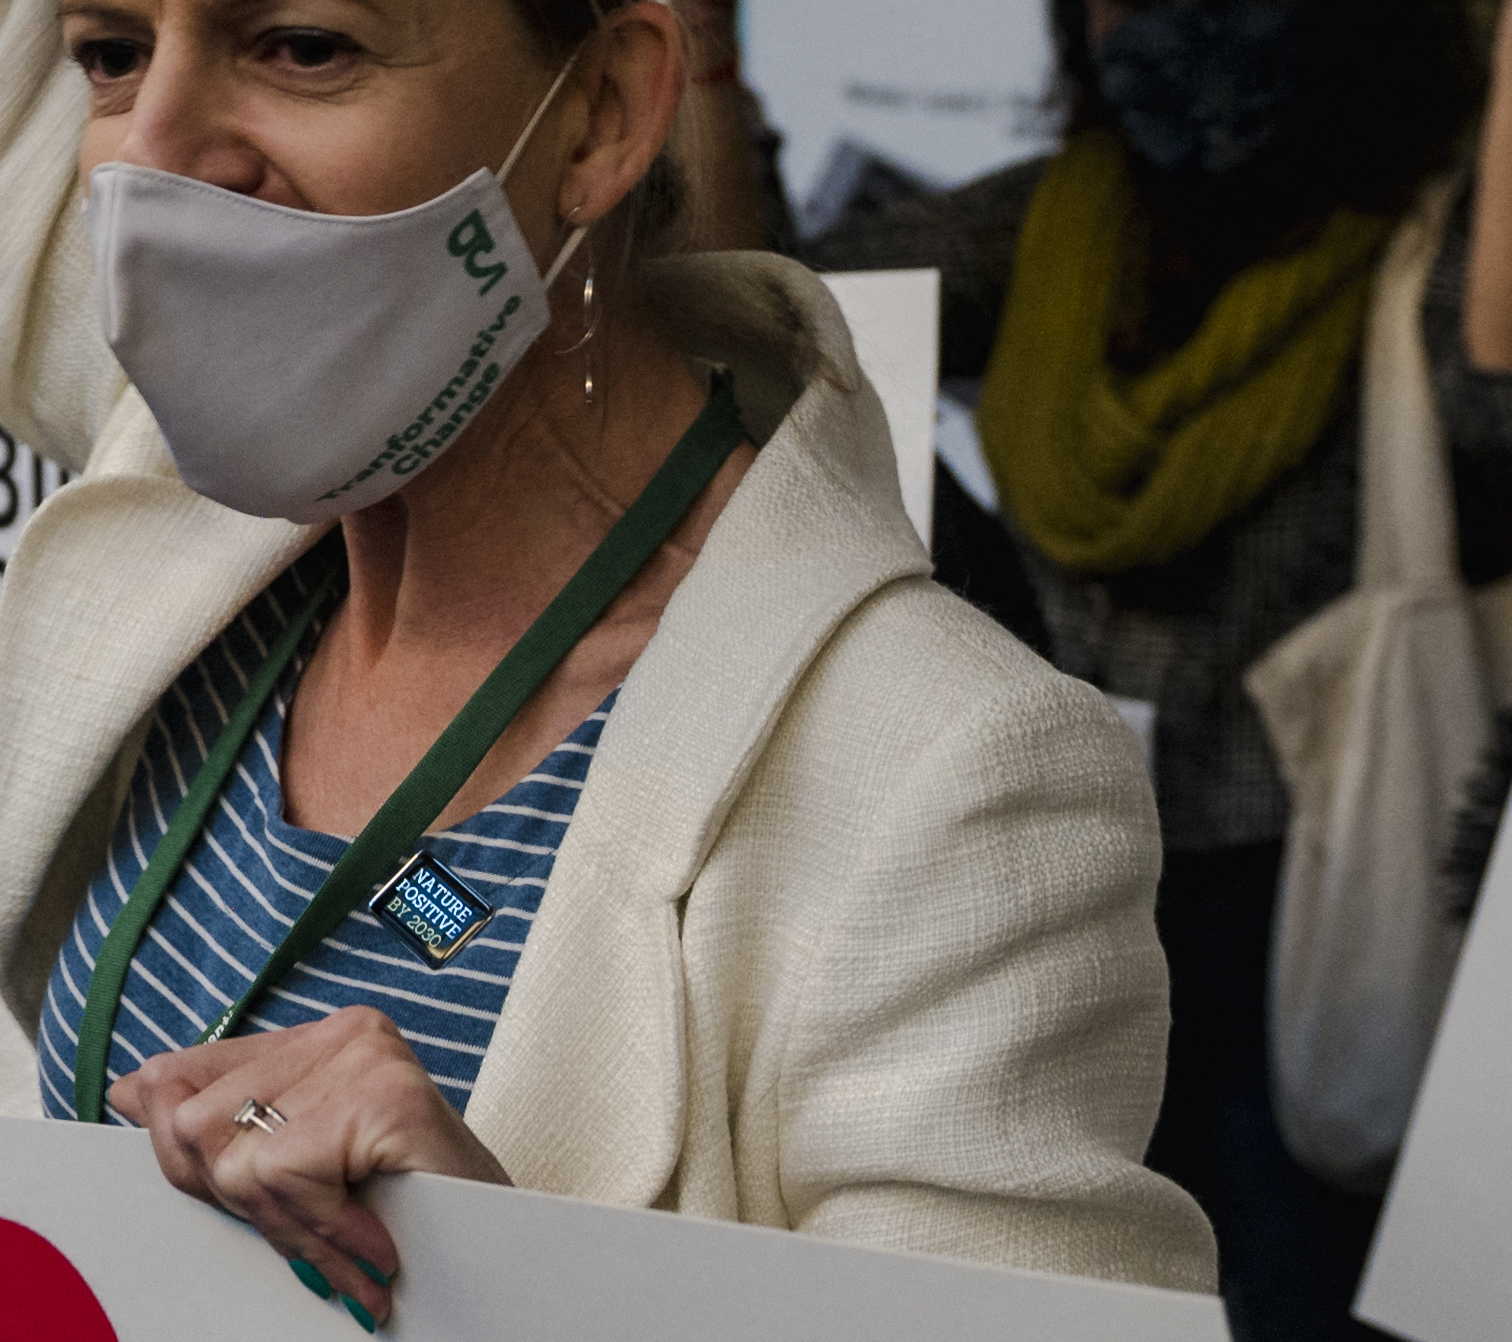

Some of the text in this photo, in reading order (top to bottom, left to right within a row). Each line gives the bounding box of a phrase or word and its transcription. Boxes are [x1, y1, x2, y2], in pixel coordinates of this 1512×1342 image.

[391, 362, 501, 476] Change
[387, 898, 441, 947] BY 2030
[396, 880, 461, 940] POSITIVE
[414, 869, 473, 923] NATURE
